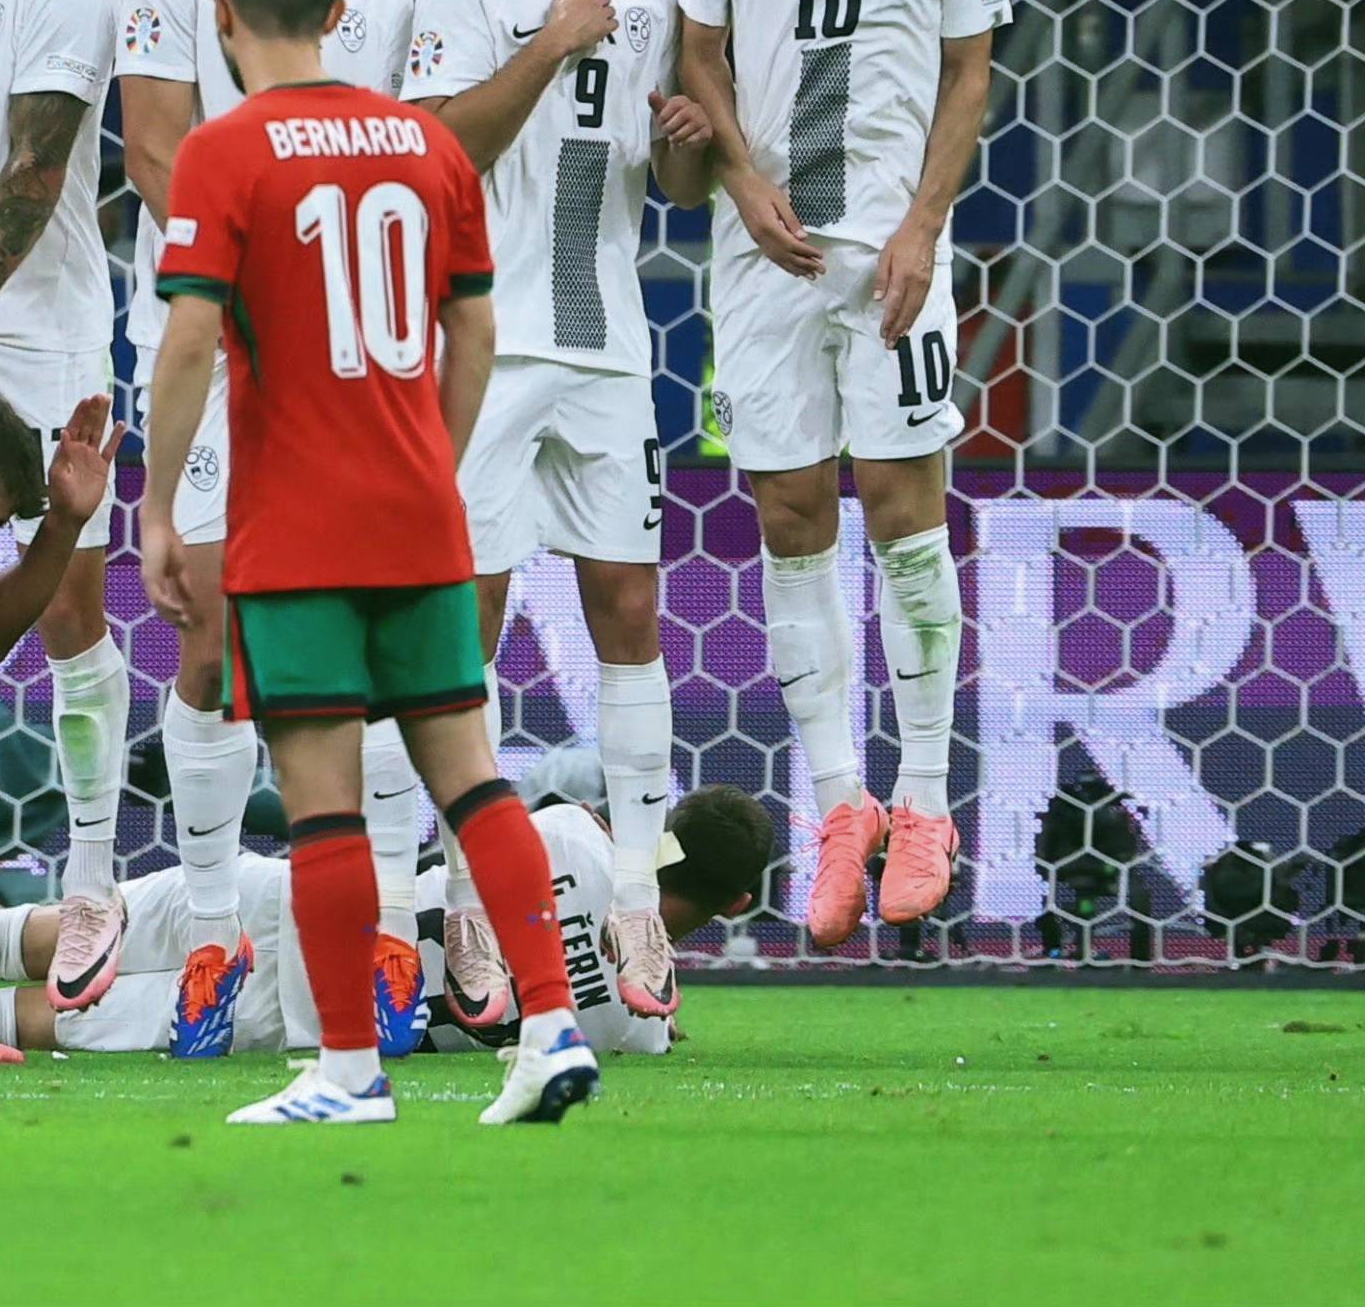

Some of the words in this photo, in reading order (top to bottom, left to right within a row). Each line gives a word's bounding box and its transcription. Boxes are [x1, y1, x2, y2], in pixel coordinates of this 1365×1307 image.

[575, 58, 609, 129] 9
[264, 115, 428, 161] BERNARDO
[294, 181, 430, 380] 10
[892, 330, 950, 407] 10
[559, 910, 612, 1012] ČERIN
